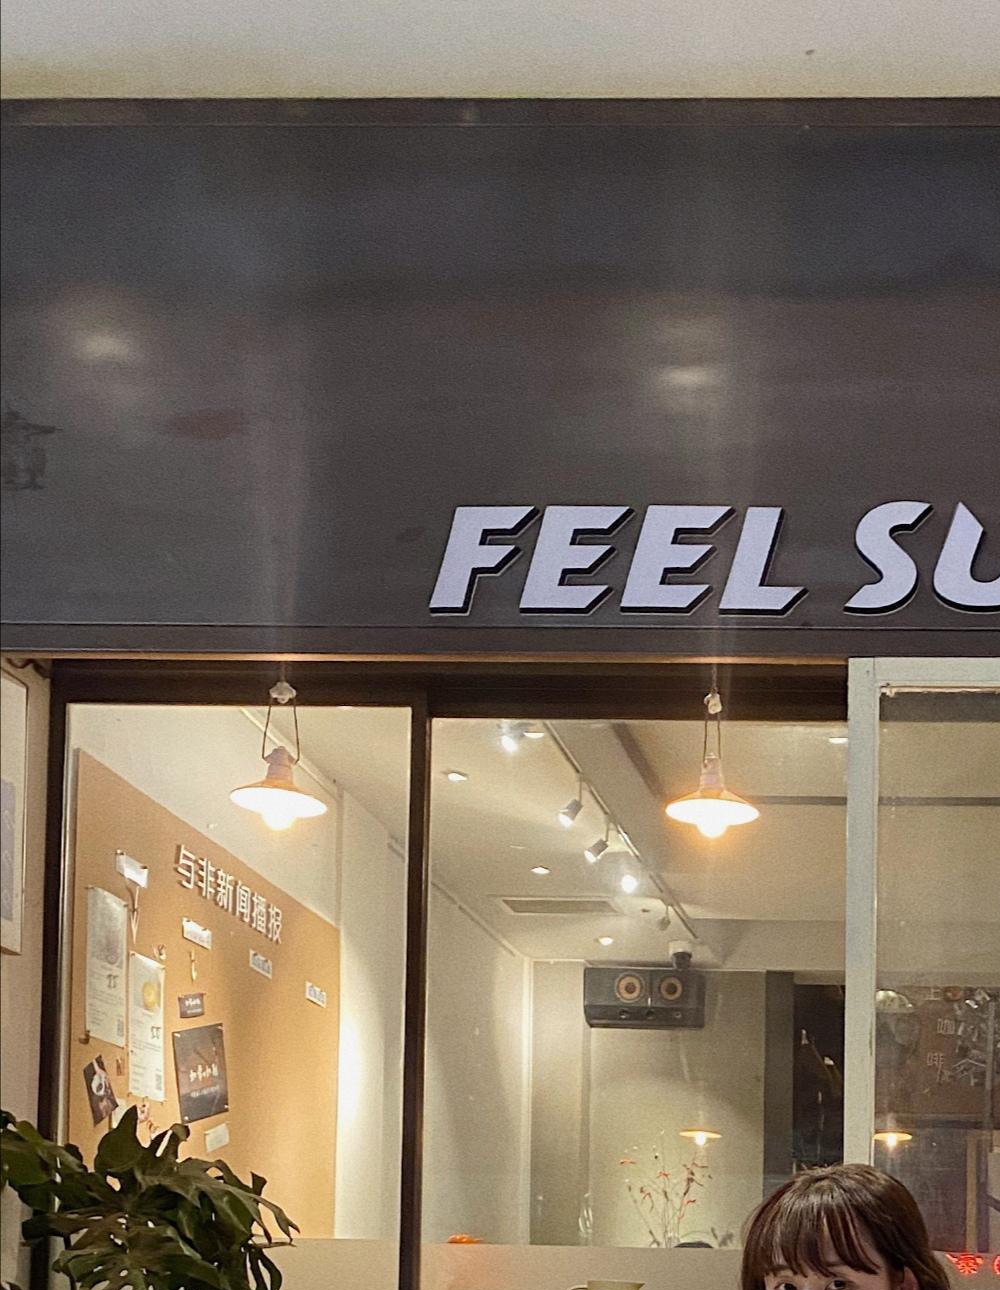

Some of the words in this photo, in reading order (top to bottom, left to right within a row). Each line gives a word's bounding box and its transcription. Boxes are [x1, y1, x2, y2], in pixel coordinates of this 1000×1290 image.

[430, 504, 807, 614] FEEL
[176, 845, 281, 944] 与非新闻播报
